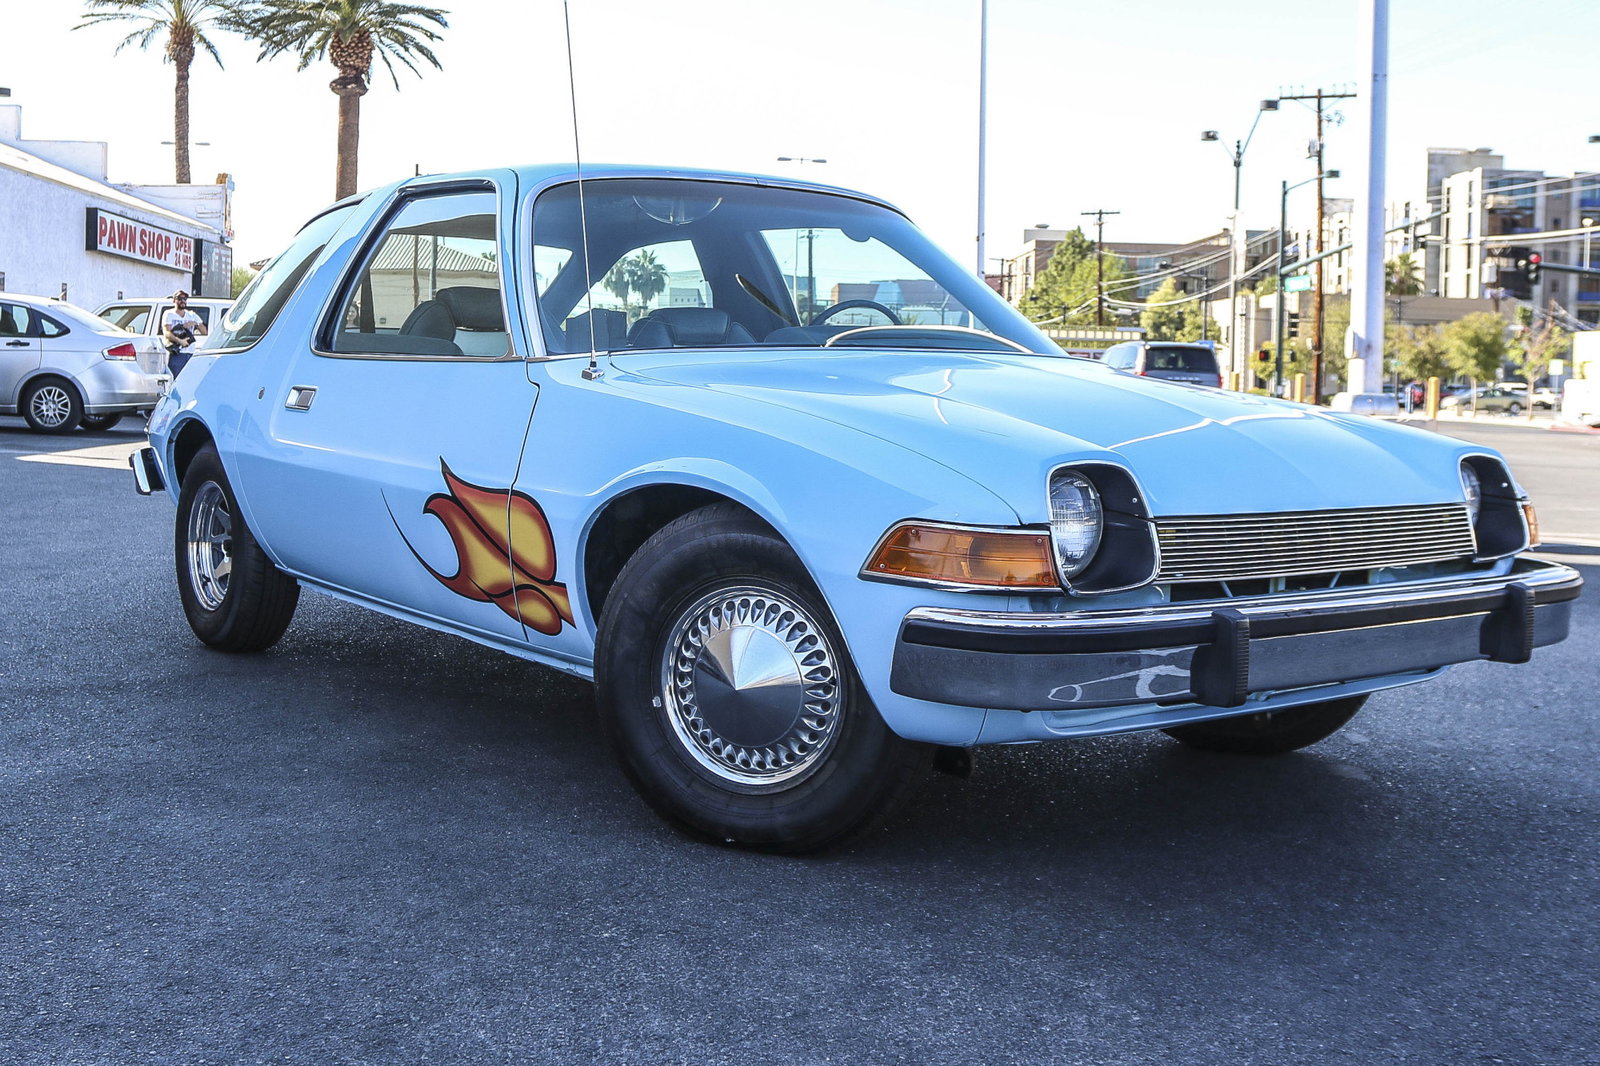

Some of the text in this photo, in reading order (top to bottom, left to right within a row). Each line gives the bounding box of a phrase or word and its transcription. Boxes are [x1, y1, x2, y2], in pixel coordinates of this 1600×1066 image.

[99, 216, 171, 261] PAWN SHOP
[175, 236, 191, 254] OPEN
[175, 253, 191, 269] 24 HRS
